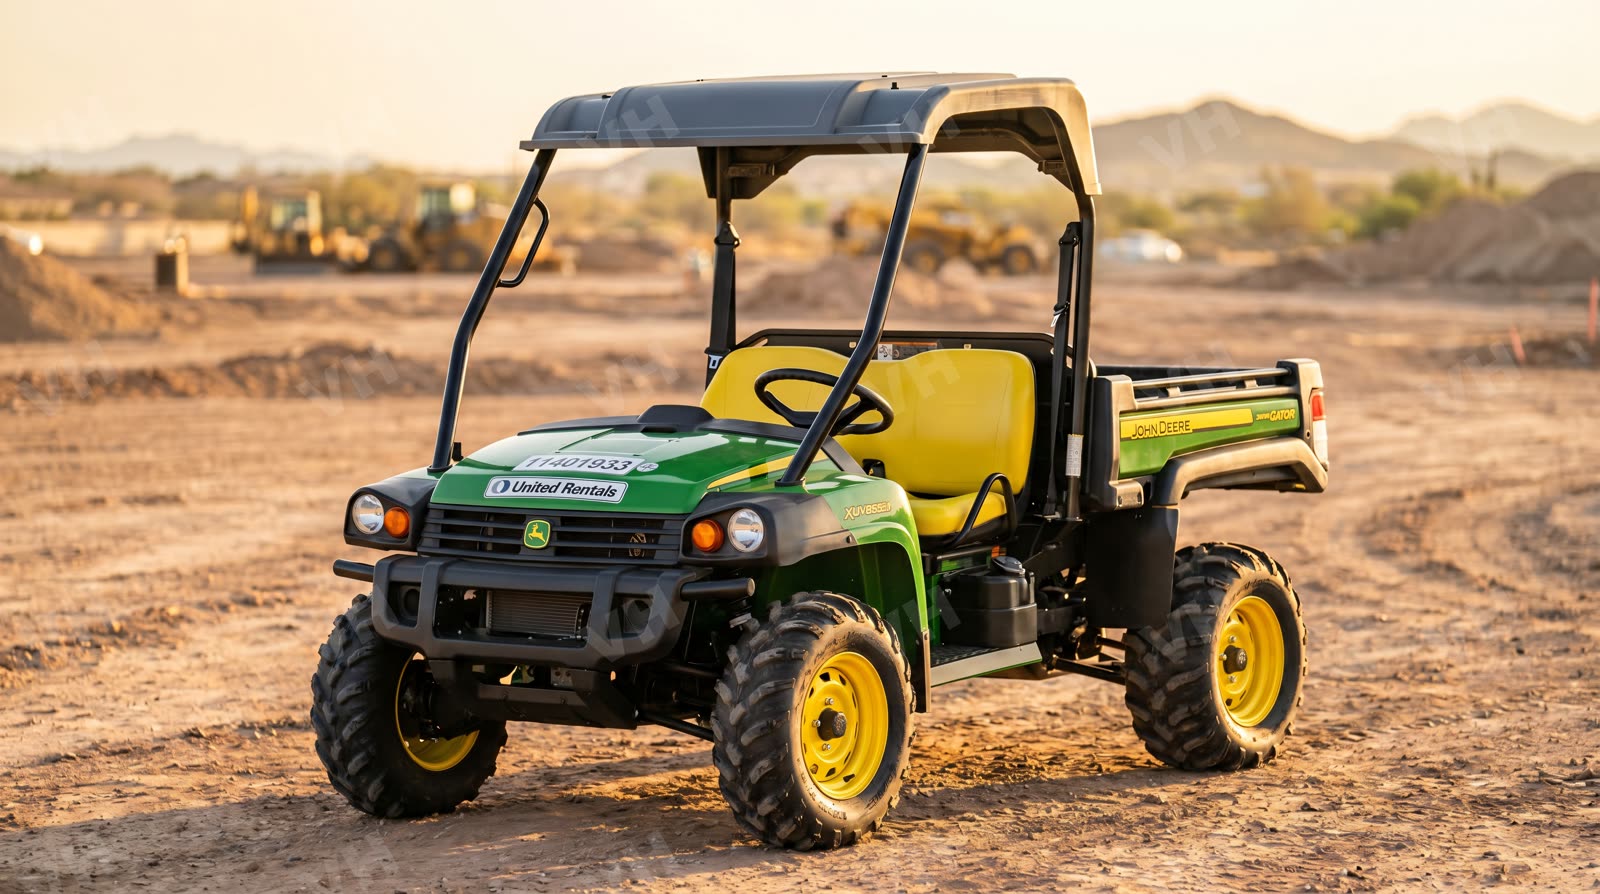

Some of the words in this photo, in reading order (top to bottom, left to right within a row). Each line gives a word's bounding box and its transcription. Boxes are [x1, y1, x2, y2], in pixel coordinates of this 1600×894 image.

[1269, 408, 1296, 421] GATOR
[1131, 422, 1158, 438] JOHN
[1159, 420, 1191, 435] DEERE
[526, 457, 632, 471] 11401933
[511, 480, 561, 495] United
[561, 481, 618, 498] Rentals
